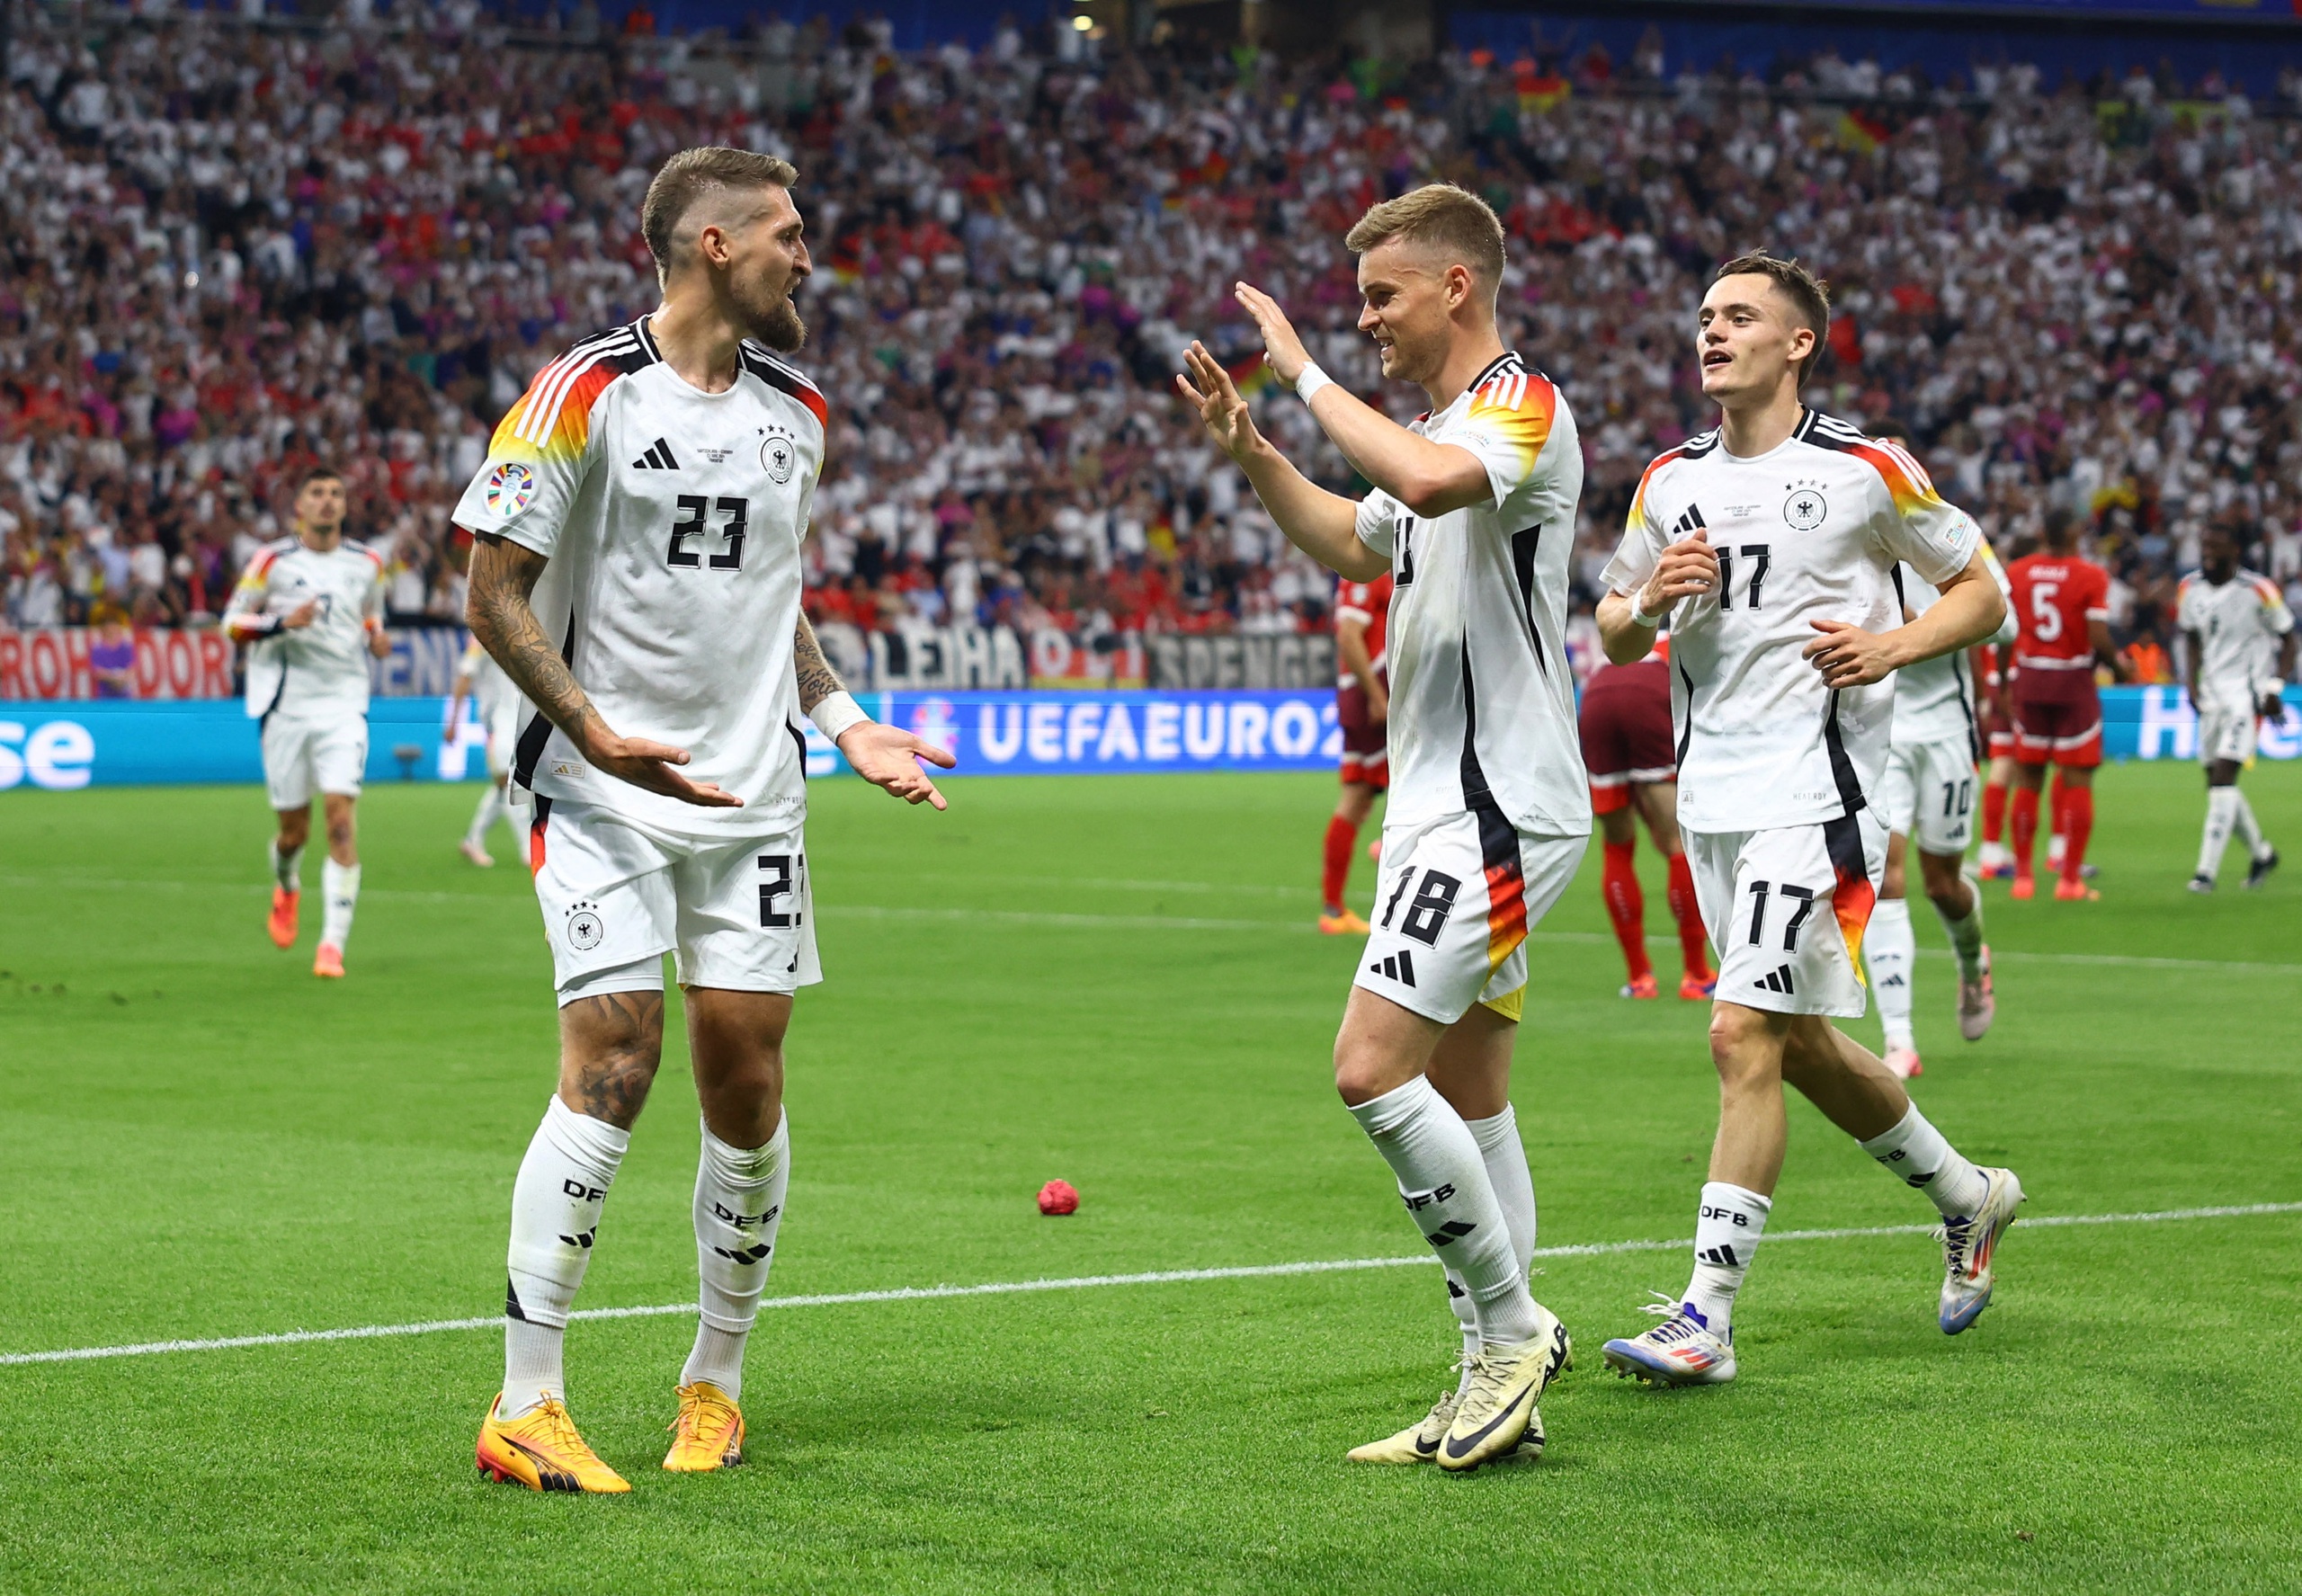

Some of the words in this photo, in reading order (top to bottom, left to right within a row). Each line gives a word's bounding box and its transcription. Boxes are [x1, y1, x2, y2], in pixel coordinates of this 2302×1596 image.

[667, 495, 749, 572] 23
[1714, 544, 1771, 611] 17
[2030, 583, 2063, 642] 5
[1942, 779, 1972, 817] 10
[757, 854, 803, 930] 2
[1379, 865, 1463, 950] 18
[1749, 879, 1816, 954] 17
[563, 1179, 607, 1202] DF
[714, 1201, 779, 1226] DFB
[1700, 1205, 1749, 1227] DFB
